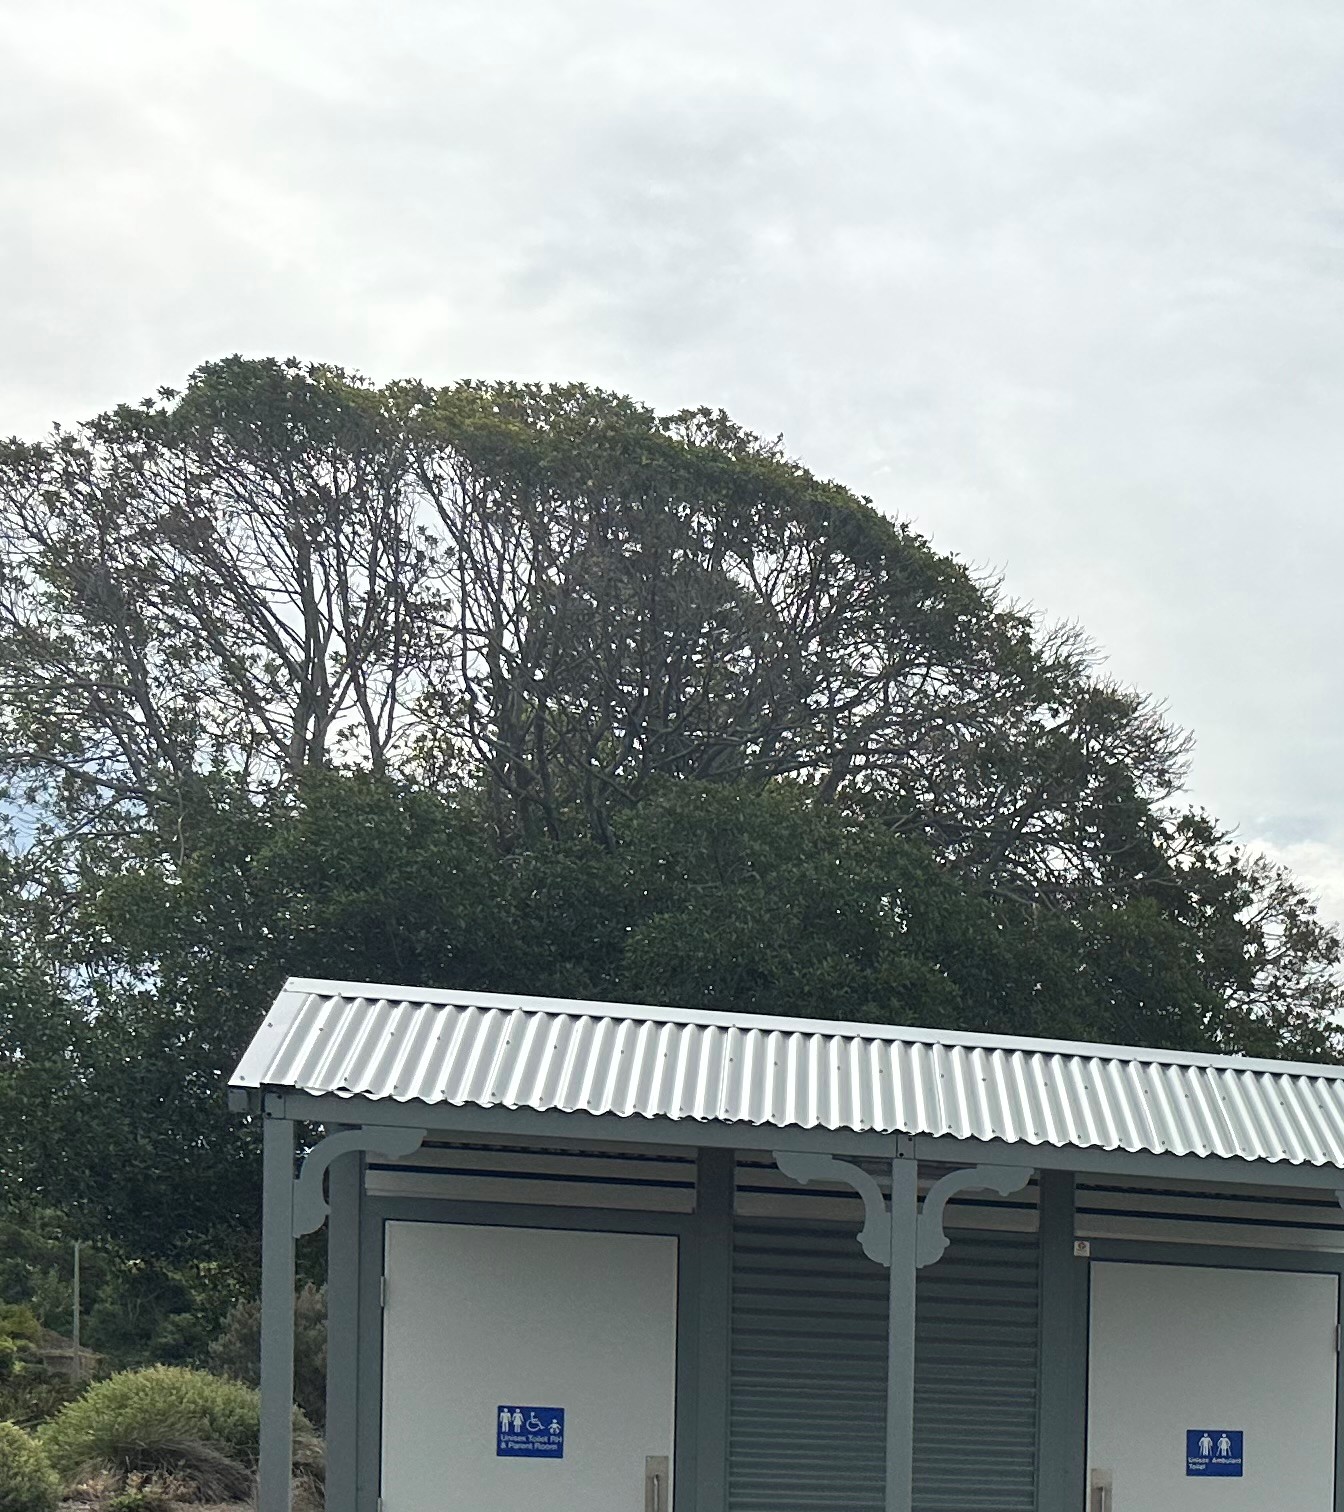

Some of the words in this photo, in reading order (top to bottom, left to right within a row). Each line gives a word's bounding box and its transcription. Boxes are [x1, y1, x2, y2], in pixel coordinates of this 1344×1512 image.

[527, 1434, 548, 1442] Toilet
[549, 1435, 562, 1443] RH
[508, 1442, 533, 1450] Parent
